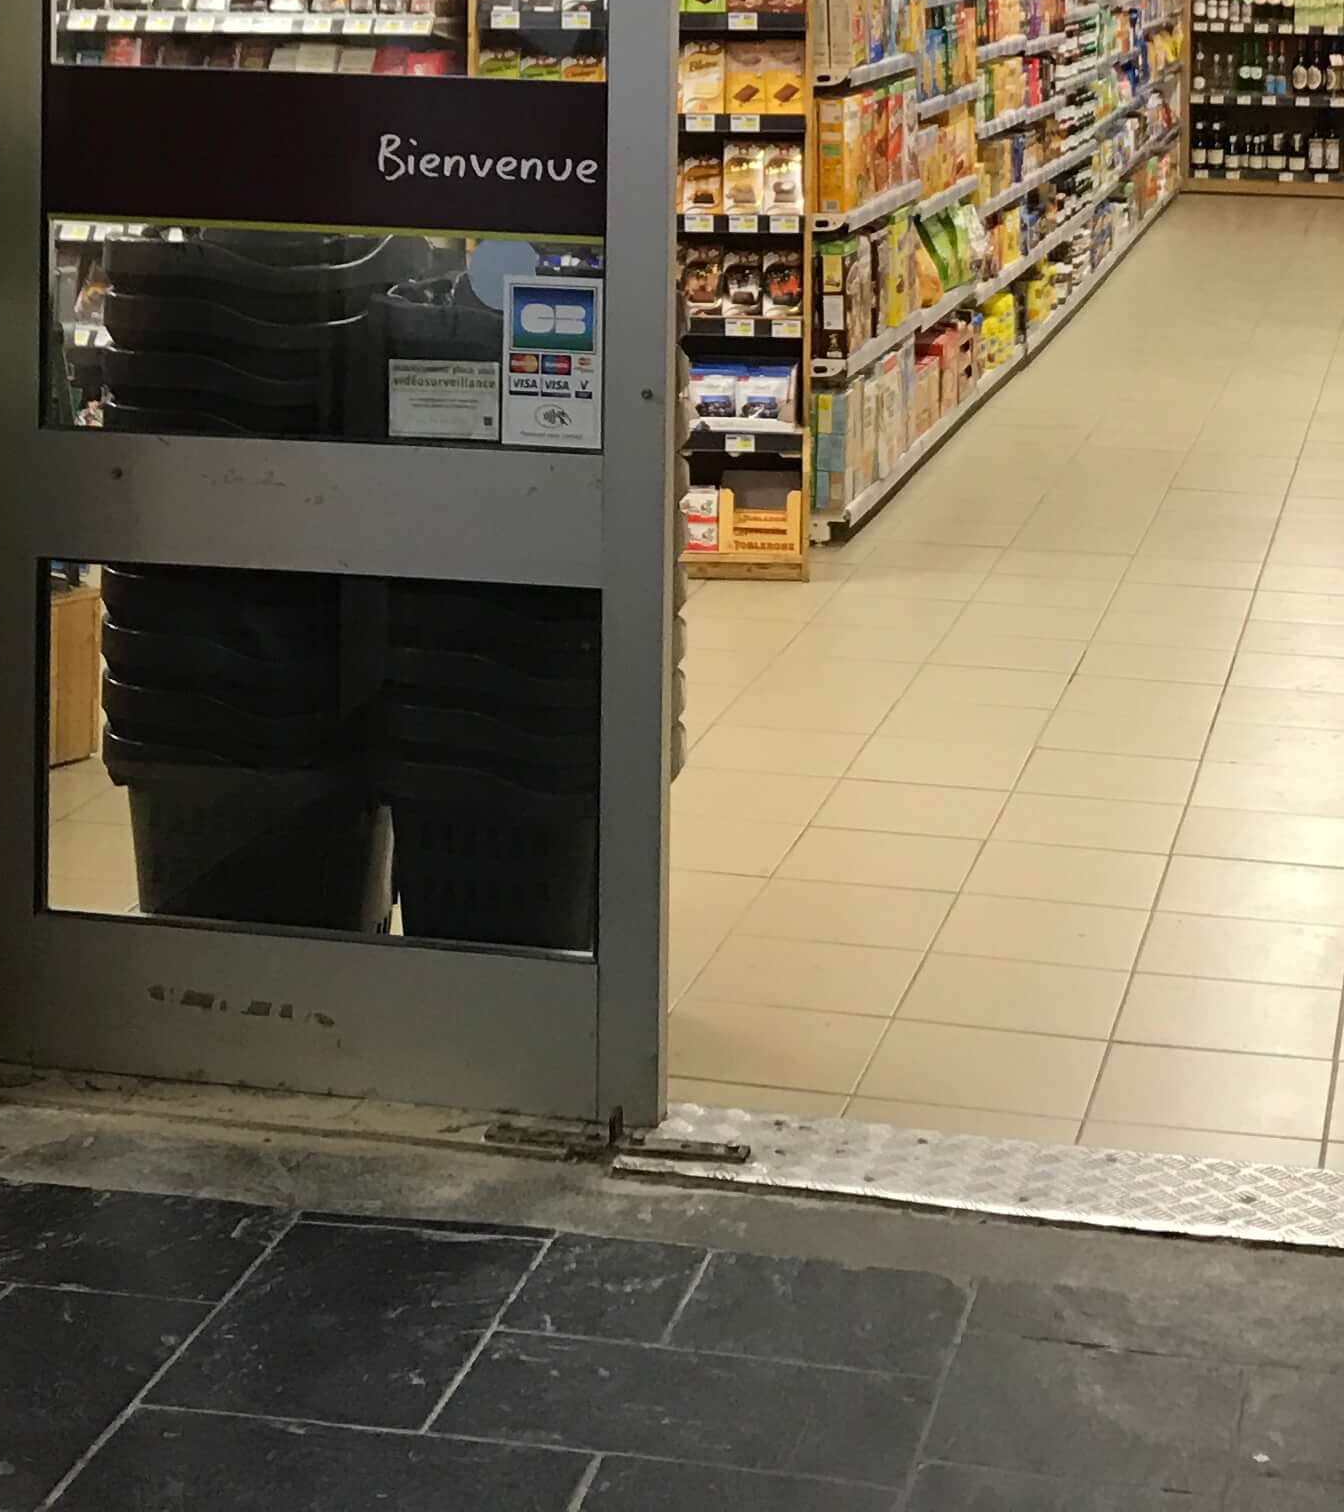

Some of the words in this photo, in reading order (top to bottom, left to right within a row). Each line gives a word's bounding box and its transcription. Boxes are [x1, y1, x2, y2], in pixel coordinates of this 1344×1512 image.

[377, 133, 599, 184] Bienvenue
[392, 374, 496, 389] vidéosurveillance
[512, 377, 538, 389] VISA
[544, 379, 570, 391] VISA
